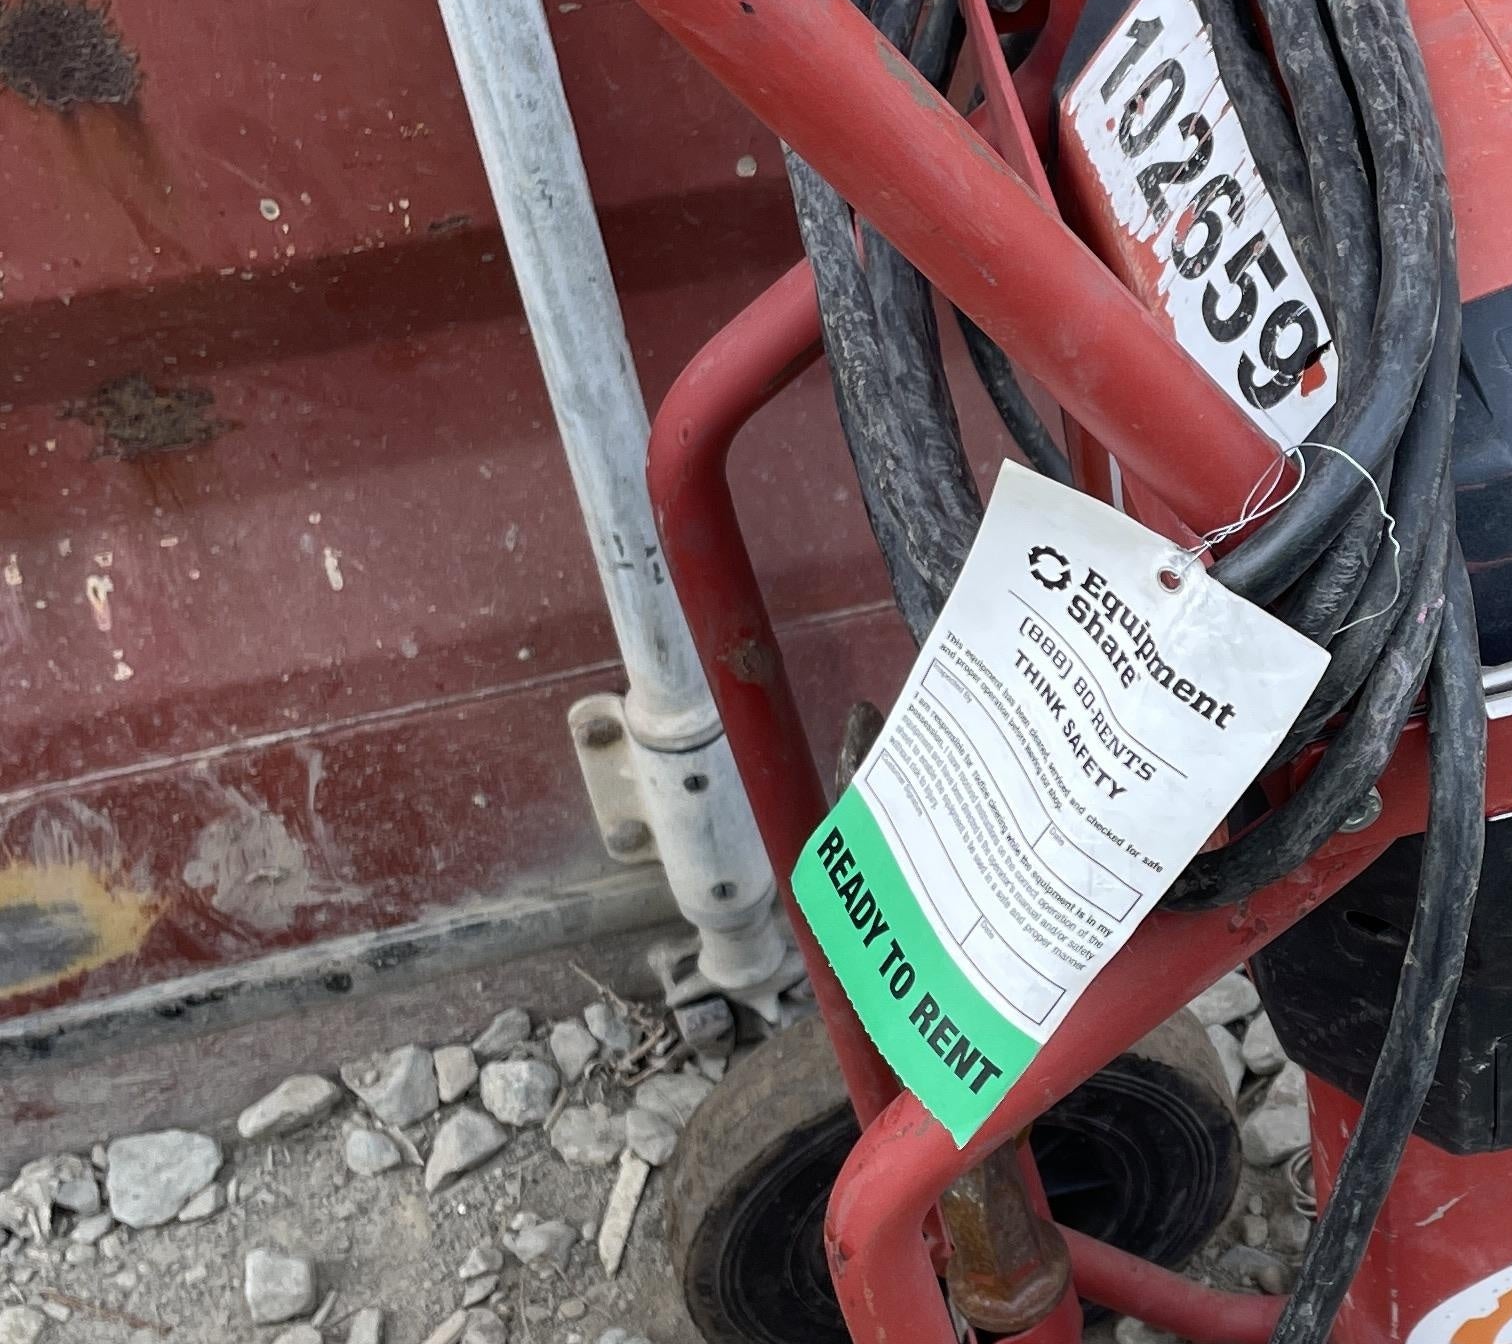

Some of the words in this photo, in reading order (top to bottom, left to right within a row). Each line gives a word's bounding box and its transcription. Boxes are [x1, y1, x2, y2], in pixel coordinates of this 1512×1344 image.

[1100, 15, 1319, 410] 102659
[939, 643, 957, 658] and
[955, 658, 980, 682] proper
[979, 683, 1009, 719] operation
[1020, 616, 1072, 679] (888)
[1073, 676, 1156, 779] 80-RENTS
[1068, 596, 1137, 688] Share
[1080, 568, 1235, 729] Equipment
[947, 631, 964, 649] This
[964, 649, 1003, 689] equipment
[1002, 688, 1016, 706] has
[1014, 704, 1030, 727] been
[1069, 797, 1086, 814] and
[1086, 814, 1125, 846] checked
[1125, 843, 1140, 857] for
[1141, 857, 1163, 873] safe
[1016, 649, 1067, 720] THINK
[1062, 721, 1127, 799] SAFETY
[930, 710, 964, 756] responsible
[1006, 832, 1020, 857] while
[1020, 854, 1032, 871] the
[1031, 870, 1076, 911] equipment
[1075, 908, 1085, 919] is
[1085, 915, 1096, 926] in
[1097, 924, 1113, 937] my
[816, 826, 890, 947] READY
[878, 938, 913, 997] TO
[909, 992, 1003, 1094] RENT
[1022, 923, 1051, 948] proper
[1052, 947, 1085, 970] manner
[1037, 897, 1077, 931] operation
[1077, 928, 1089, 937] of
[1088, 934, 1103, 949] the
[1039, 918, 1068, 943] and/or
[1067, 940, 1094, 961] safety
